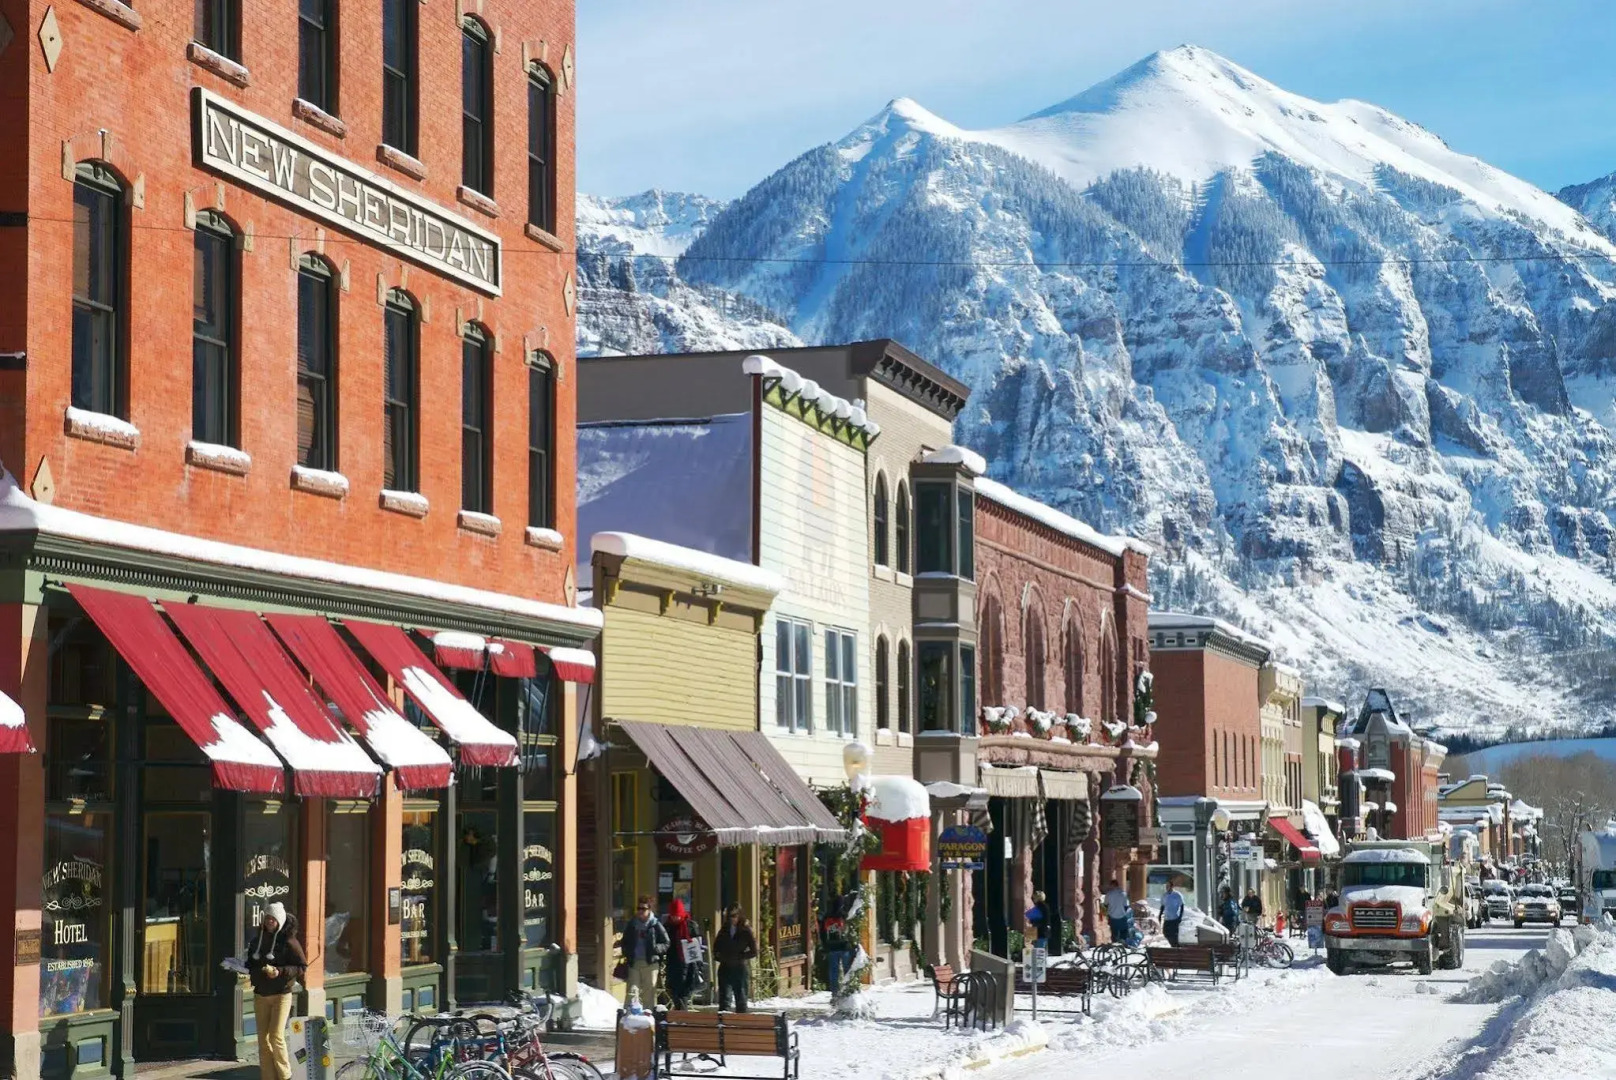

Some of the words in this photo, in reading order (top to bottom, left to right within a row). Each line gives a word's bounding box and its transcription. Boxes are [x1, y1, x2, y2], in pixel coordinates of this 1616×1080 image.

[207, 107, 297, 192] NEW
[939, 842, 985, 851] PARAGON
[62, 860, 102, 889] SHERIDAN
[402, 898, 426, 919] BAR
[525, 888, 546, 908] BAR
[54, 919, 89, 945] HOTEL
[47, 960, 83, 972] ESTABLISHED
